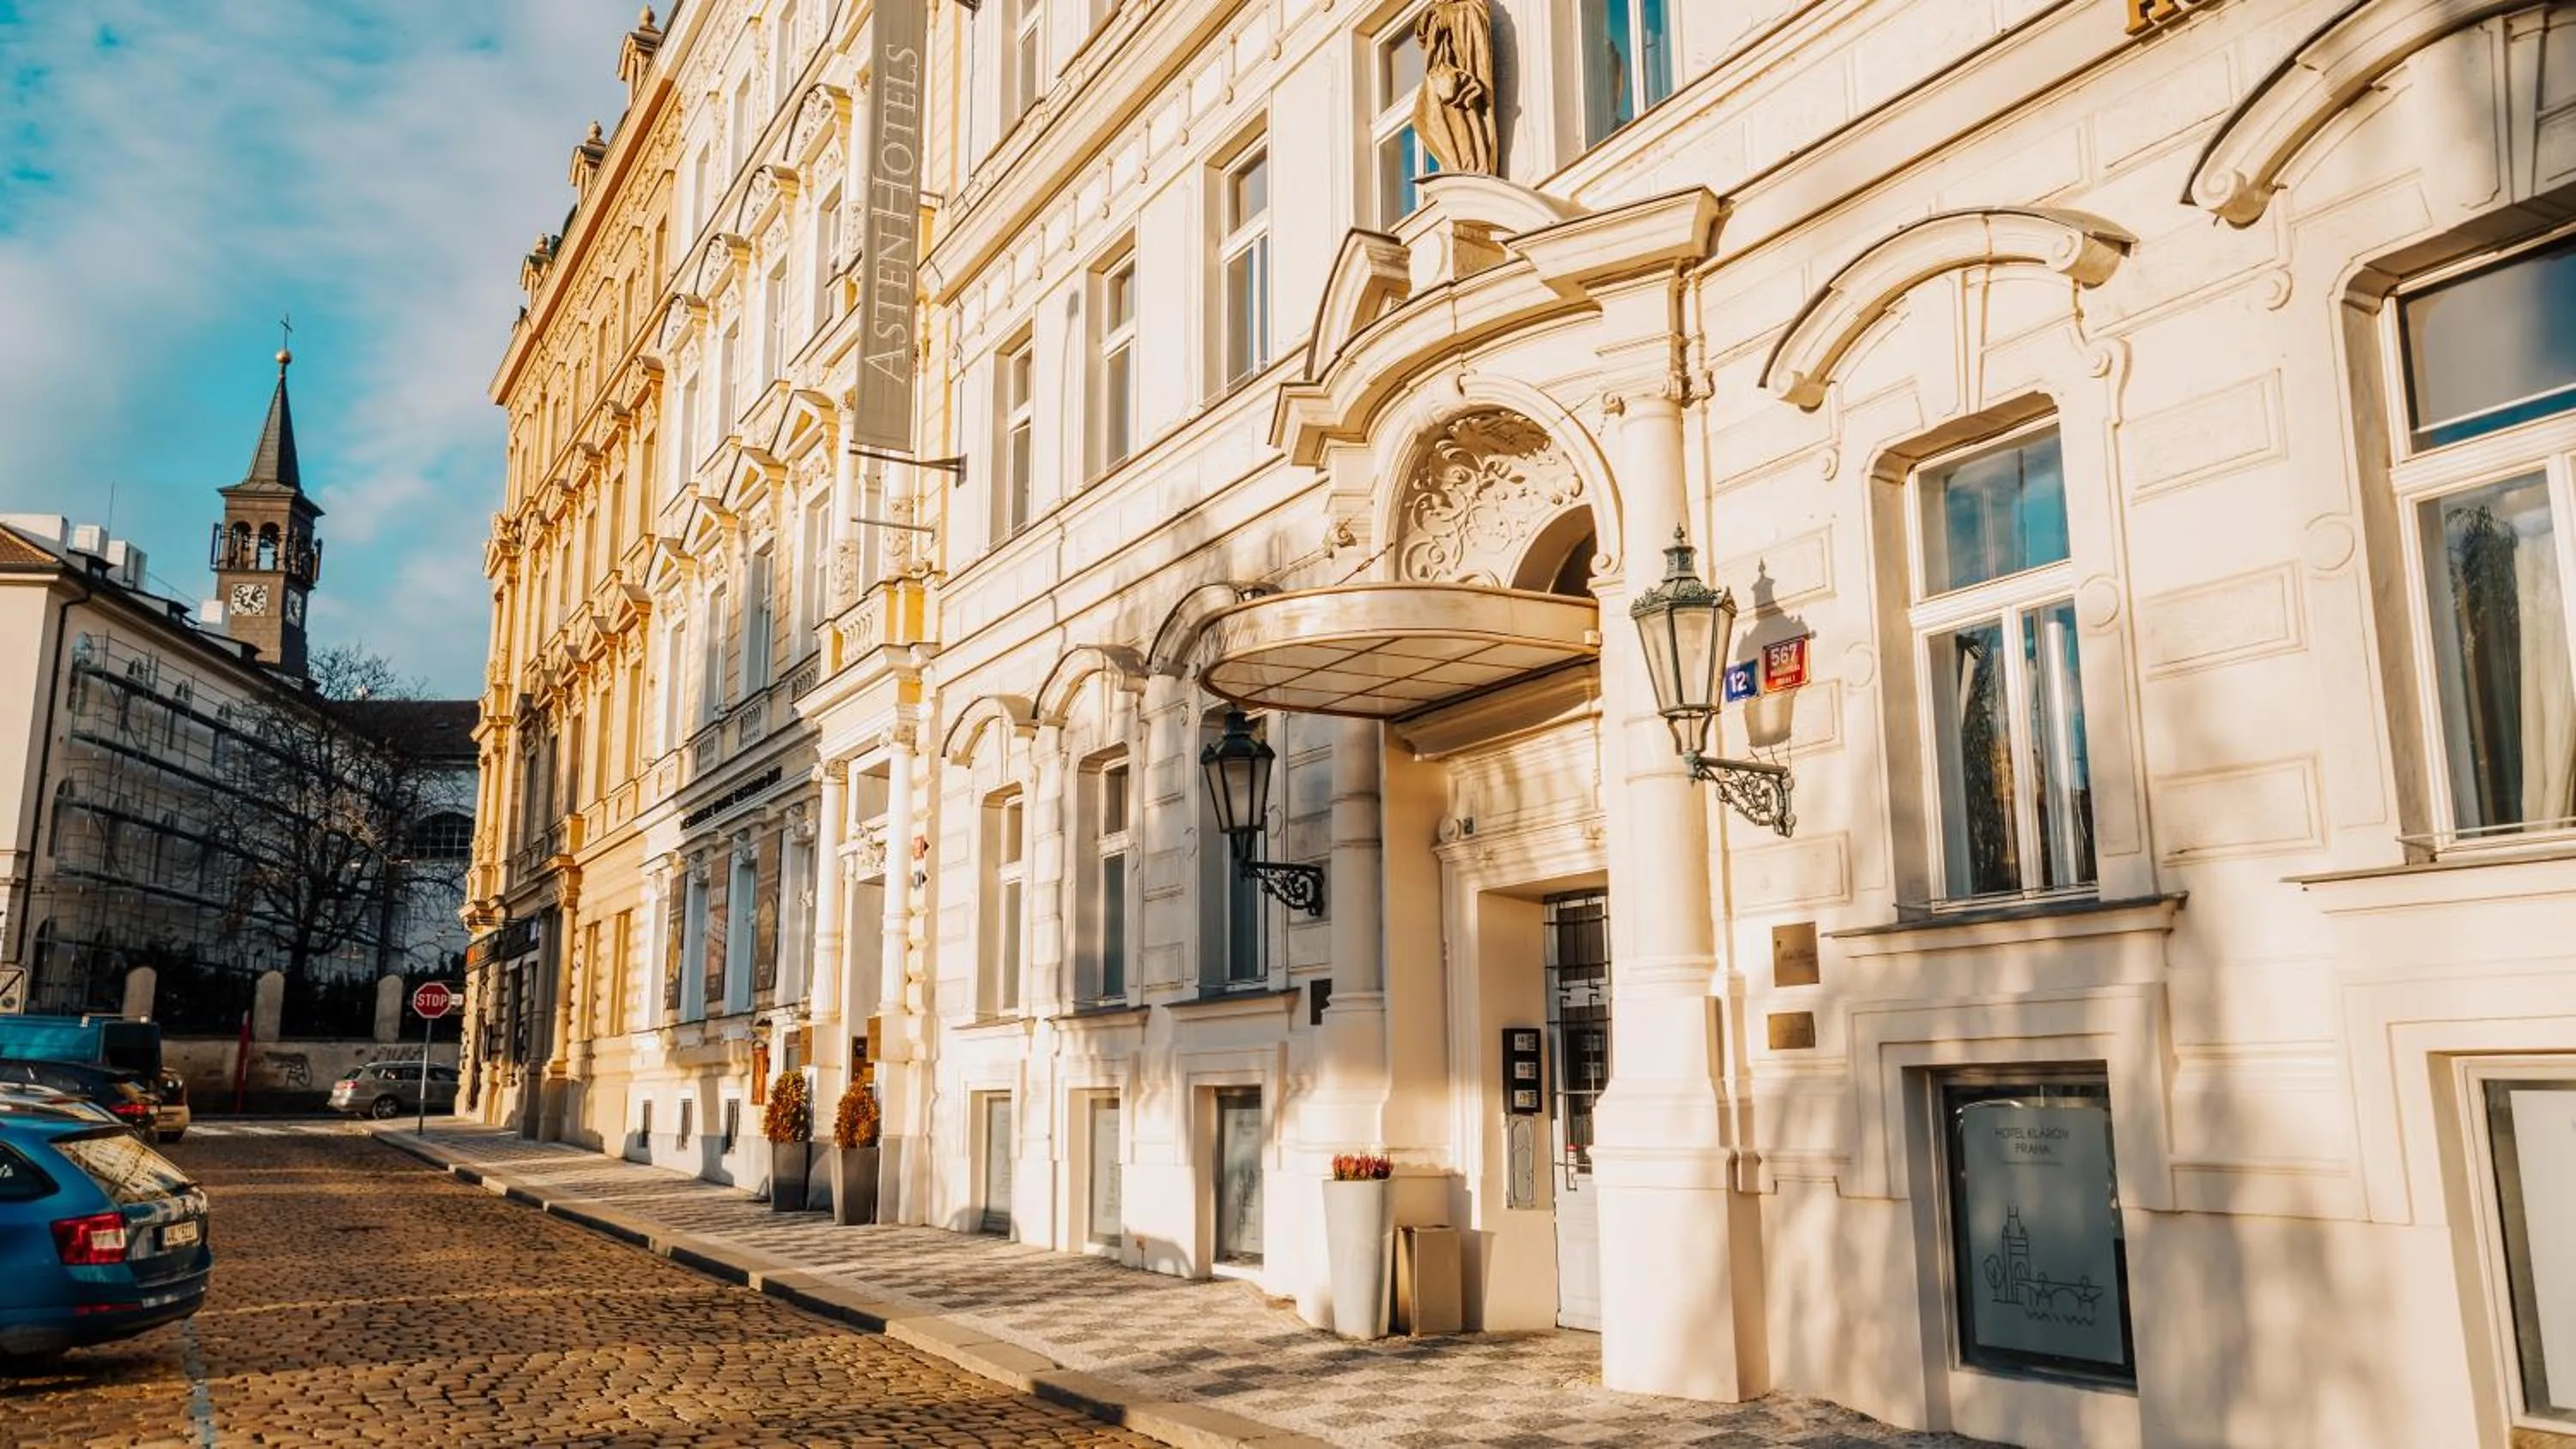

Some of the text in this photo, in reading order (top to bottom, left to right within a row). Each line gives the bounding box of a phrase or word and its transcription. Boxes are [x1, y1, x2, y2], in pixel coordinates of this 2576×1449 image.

[865, 44, 919, 384] ASTEN HOTELS
[1771, 644, 1796, 666] 567
[1730, 671, 1747, 693] 12
[417, 993, 447, 1007] STOP
